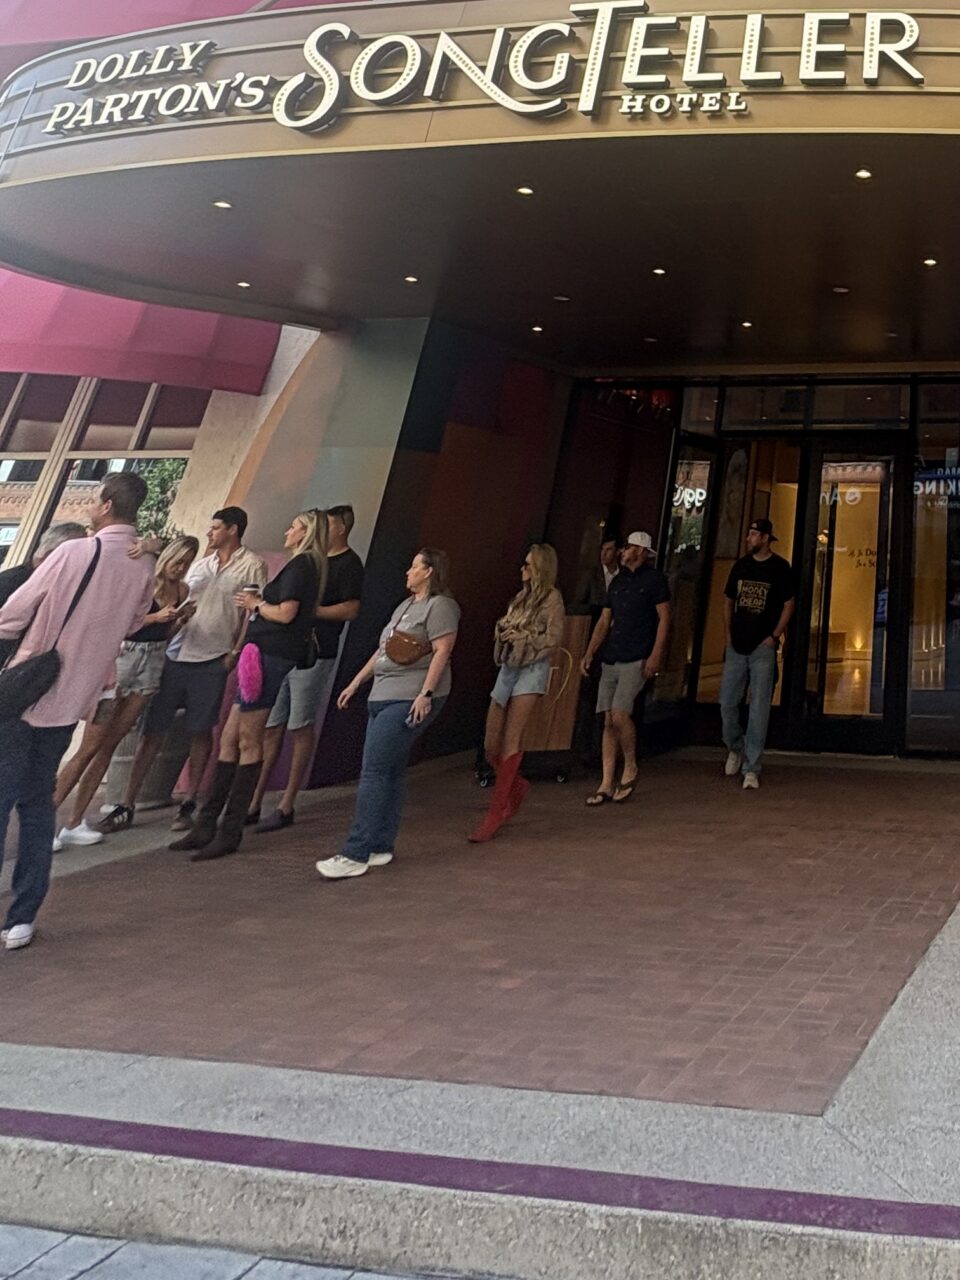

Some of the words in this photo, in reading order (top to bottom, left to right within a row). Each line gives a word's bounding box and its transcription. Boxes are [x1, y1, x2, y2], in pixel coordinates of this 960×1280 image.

[64, 40, 211, 89] DOLLY
[42, 72, 271, 133] PARTON'S
[619, 91, 748, 114] HOTEL
